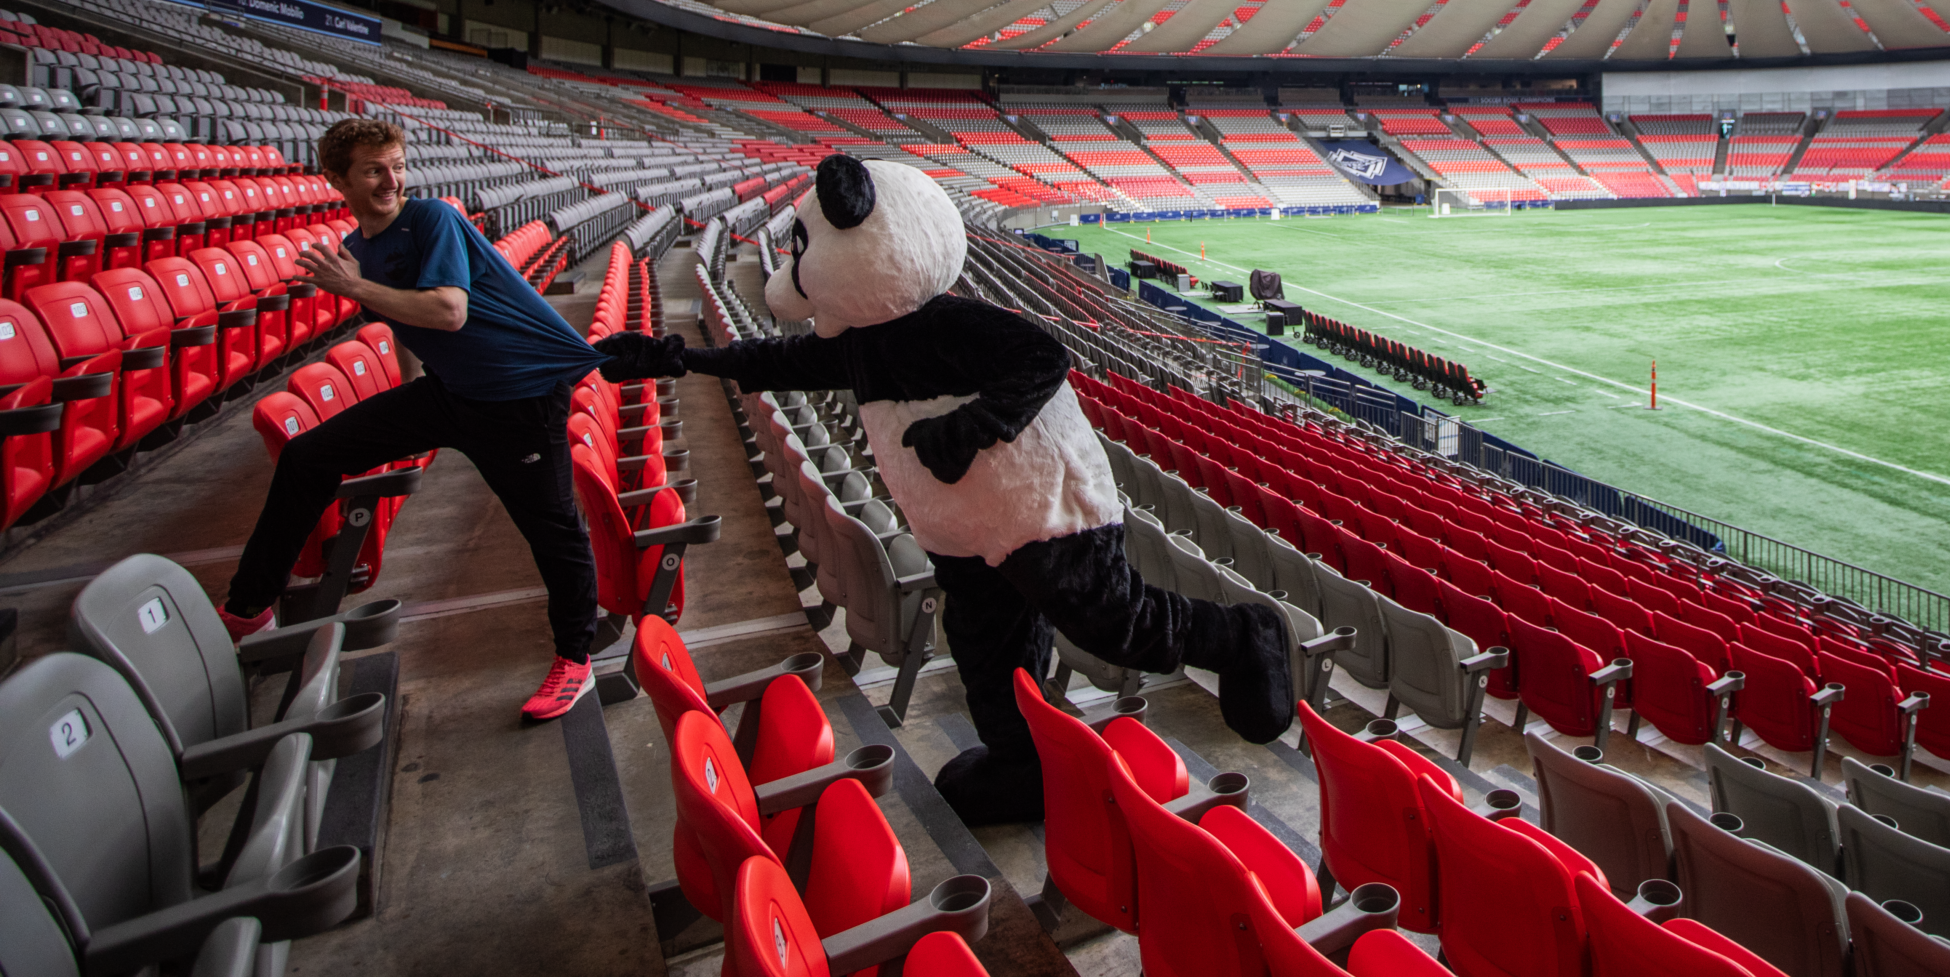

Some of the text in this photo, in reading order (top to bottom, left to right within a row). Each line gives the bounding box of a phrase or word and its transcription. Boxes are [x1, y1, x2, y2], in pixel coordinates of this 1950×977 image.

[249, 0, 280, 14] Domenic
[280, 2, 304, 19] Mobilio
[335, 16, 347, 29] Carl
[73, 304, 87, 316] 103
[322, 387, 333, 399] 102
[287, 421, 298, 432] 101
[355, 512, 364, 522] P
[666, 557, 675, 567] O
[925, 601, 933, 610] N
[147, 607, 156, 624] 1
[1324, 661, 1330, 669] L
[61, 721, 77, 747] 2
[707, 767, 715, 788] 2
[776, 934, 784, 959] 3
